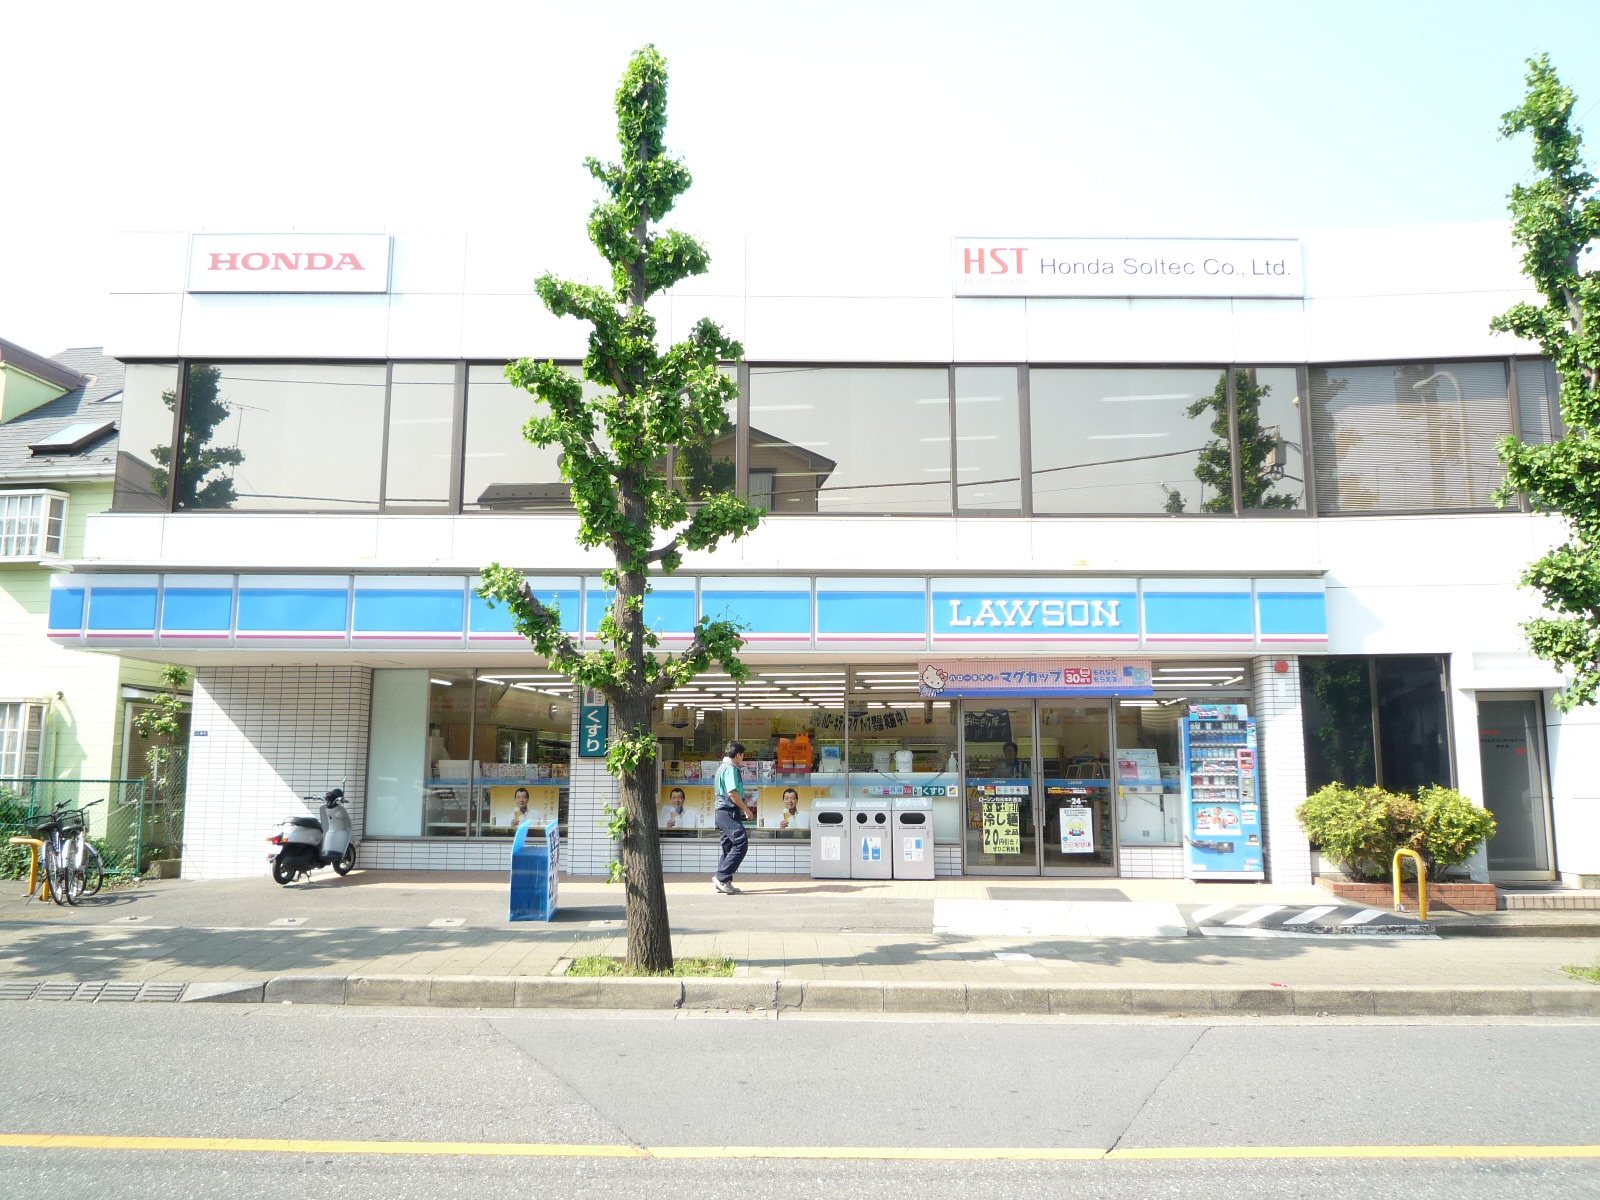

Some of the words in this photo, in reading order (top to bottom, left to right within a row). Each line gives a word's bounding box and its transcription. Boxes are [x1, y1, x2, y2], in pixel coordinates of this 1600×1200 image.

[207, 252, 366, 271] HONDA
[964, 248, 1029, 275] HST
[1040, 258, 1115, 275] Honda
[1123, 258, 1195, 275] Soltec
[1203, 259, 1245, 278] Co.,
[1252, 259, 1291, 276] Ltd.
[949, 599, 1122, 628] LAWSON
[585, 709, 603, 752] くすり
[922, 787, 945, 796] くすり
[1071, 797, 1081, 805] 24
[983, 812, 1019, 827] 冷し麺
[1004, 828, 1019, 836] 全品
